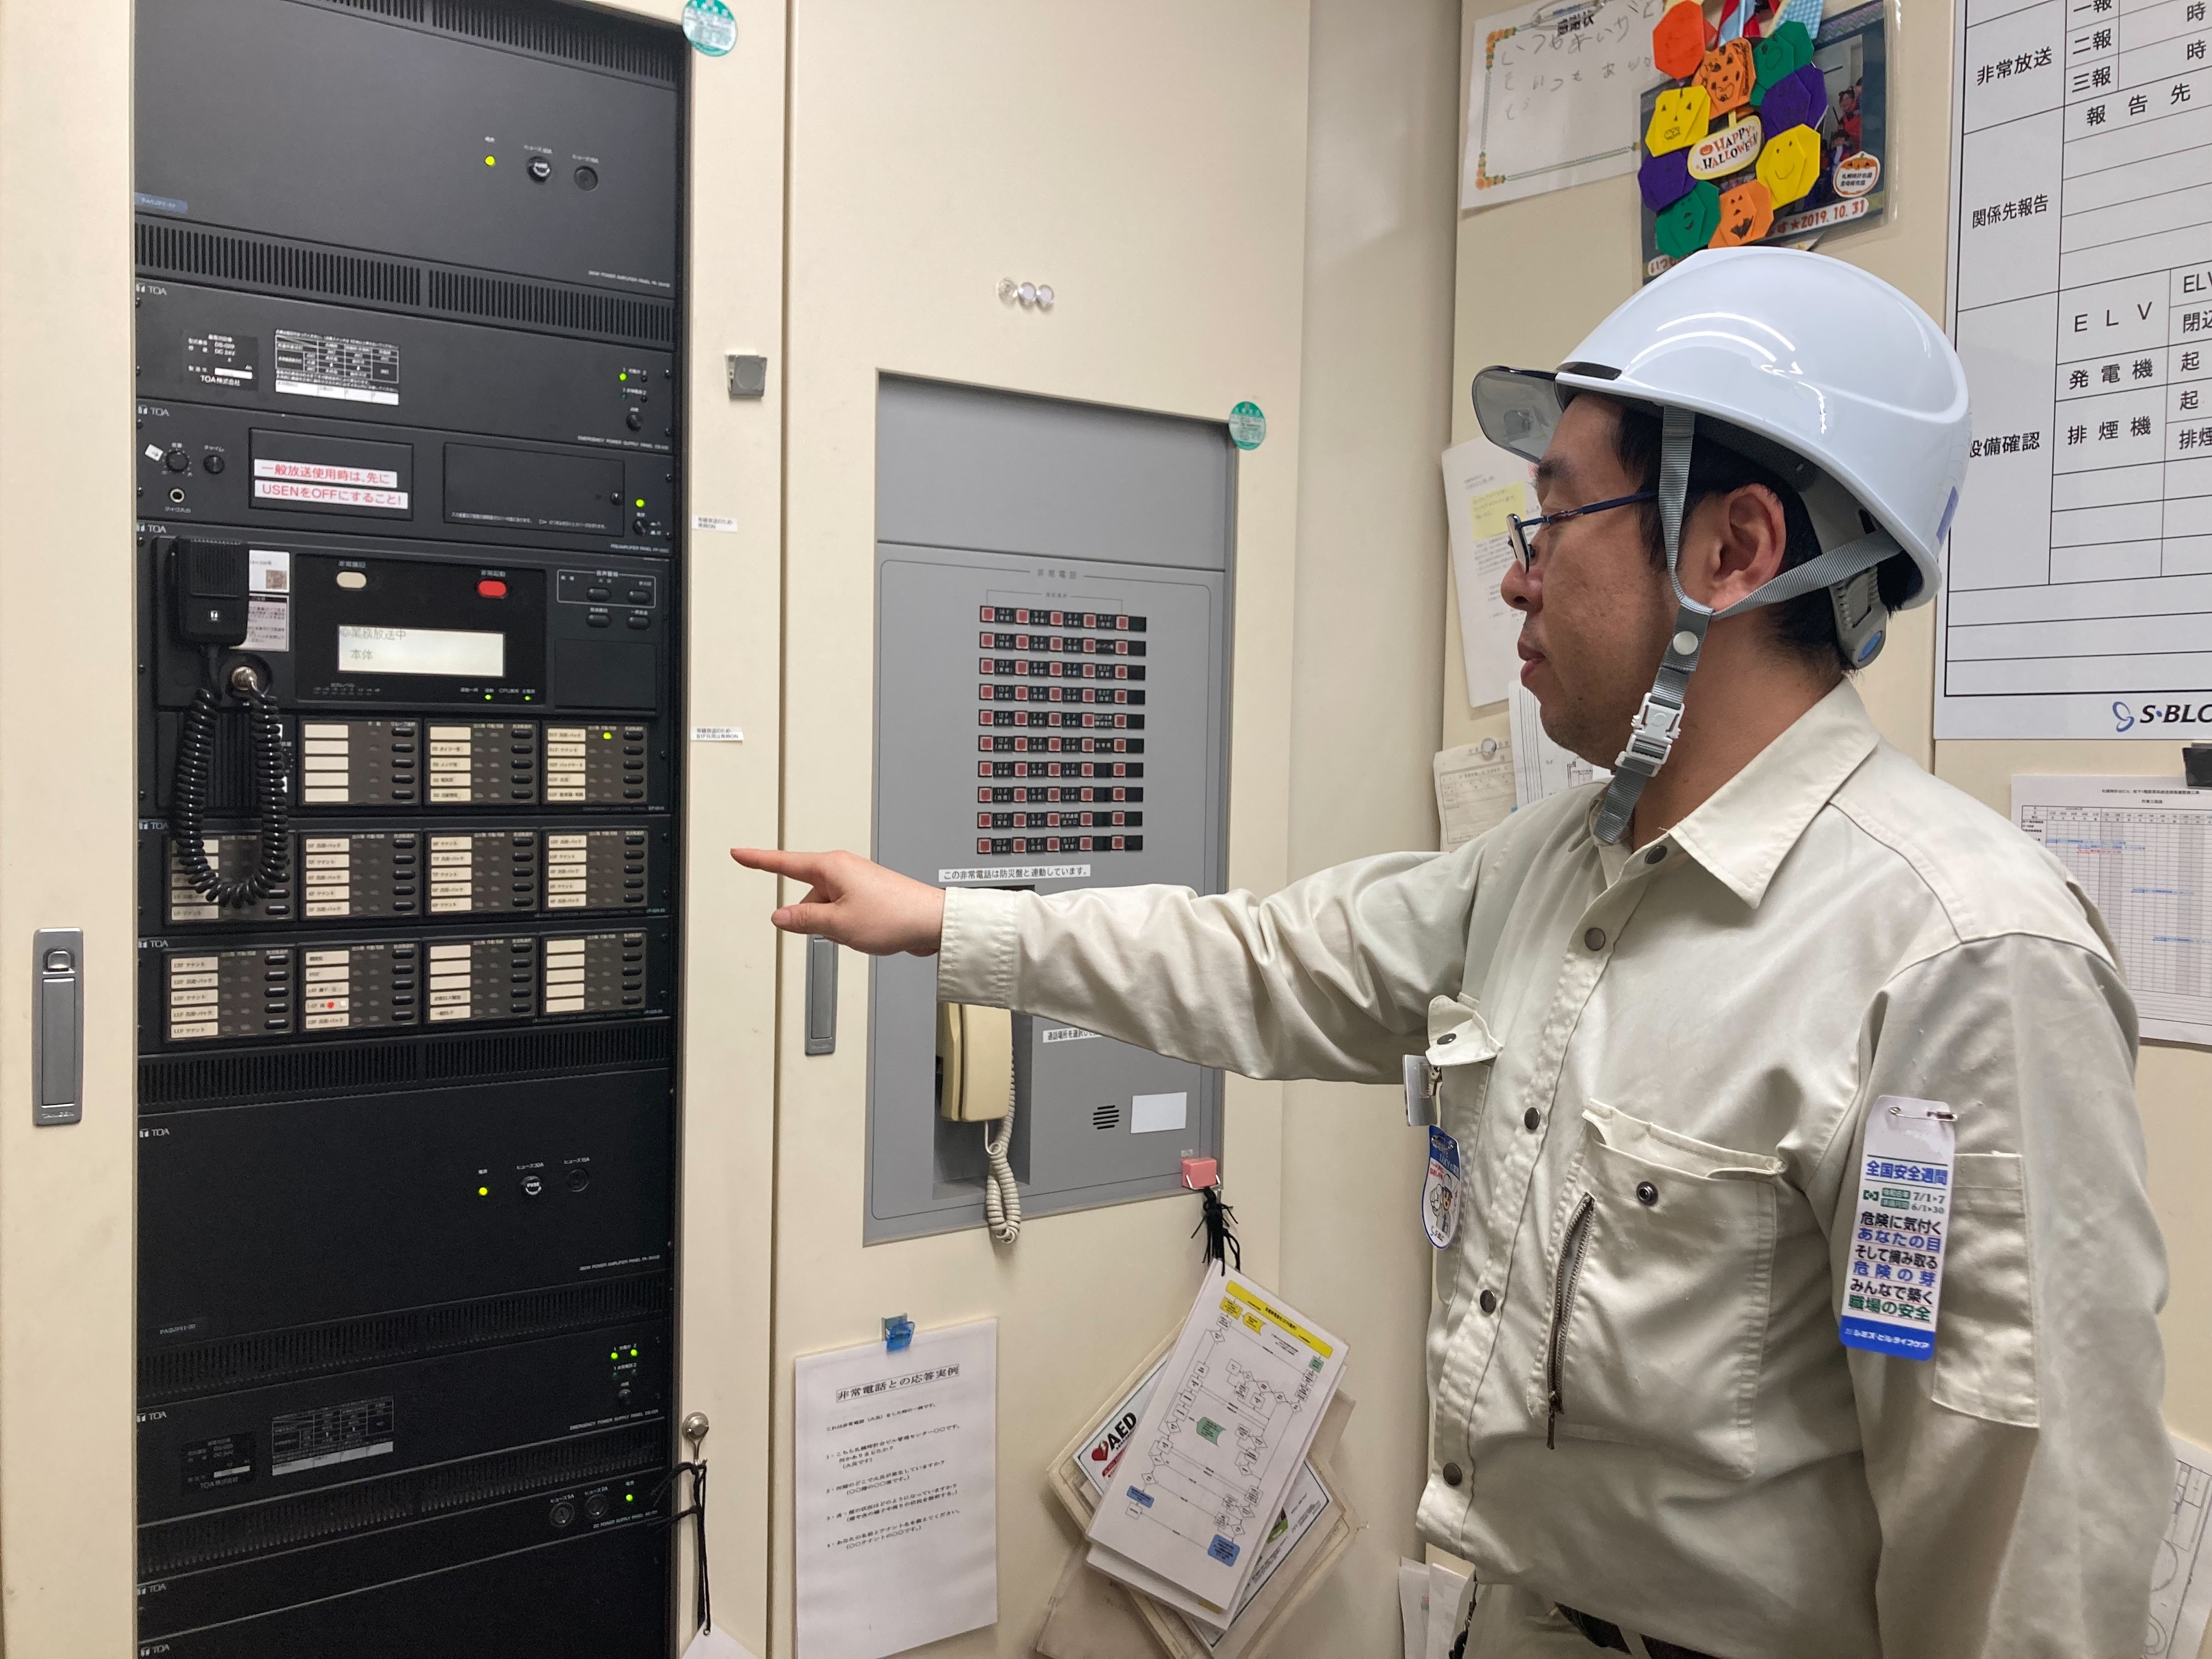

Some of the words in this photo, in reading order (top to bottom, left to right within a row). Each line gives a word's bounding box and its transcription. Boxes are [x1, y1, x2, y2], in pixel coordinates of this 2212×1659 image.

[2187, 1, 2206, 22] 時
[2073, 28, 2112, 54] 二報
[2187, 40, 2207, 60] 時
[1977, 46, 2053, 86] 非常放送
[2072, 65, 2111, 93] 三報
[1713, 125, 1752, 152] HAPPY
[1702, 132, 1758, 170] HALLOWEEN
[1852, 200, 1865, 215] 31
[1972, 194, 2049, 229] 関係先報告
[148, 285, 167, 296] TOA
[2181, 351, 2200, 371] 起
[150, 407, 170, 417] TOA
[2180, 390, 2199, 410] 起
[148, 524, 166, 534] TOA
[944, 866, 1087, 880] この非常電話は防災盤と連動しています。
[150, 940, 168, 948] TOA
[151, 1128, 170, 1136] TOA
[1866, 1160, 1948, 1186] 全国安全週間
[1860, 1211, 1941, 1234] 危険に気付く
[1858, 1227, 1940, 1253] あなたの目
[1855, 1244, 1938, 1269] そして摘み取る
[1850, 1278, 1933, 1305] みんなで築く
[1848, 1294, 1931, 1321] 職場の安全
[838, 1365, 959, 1400] 非常電話との応答実例
[149, 1411, 167, 1420] TOA
[1107, 1412, 1137, 1451] AED
